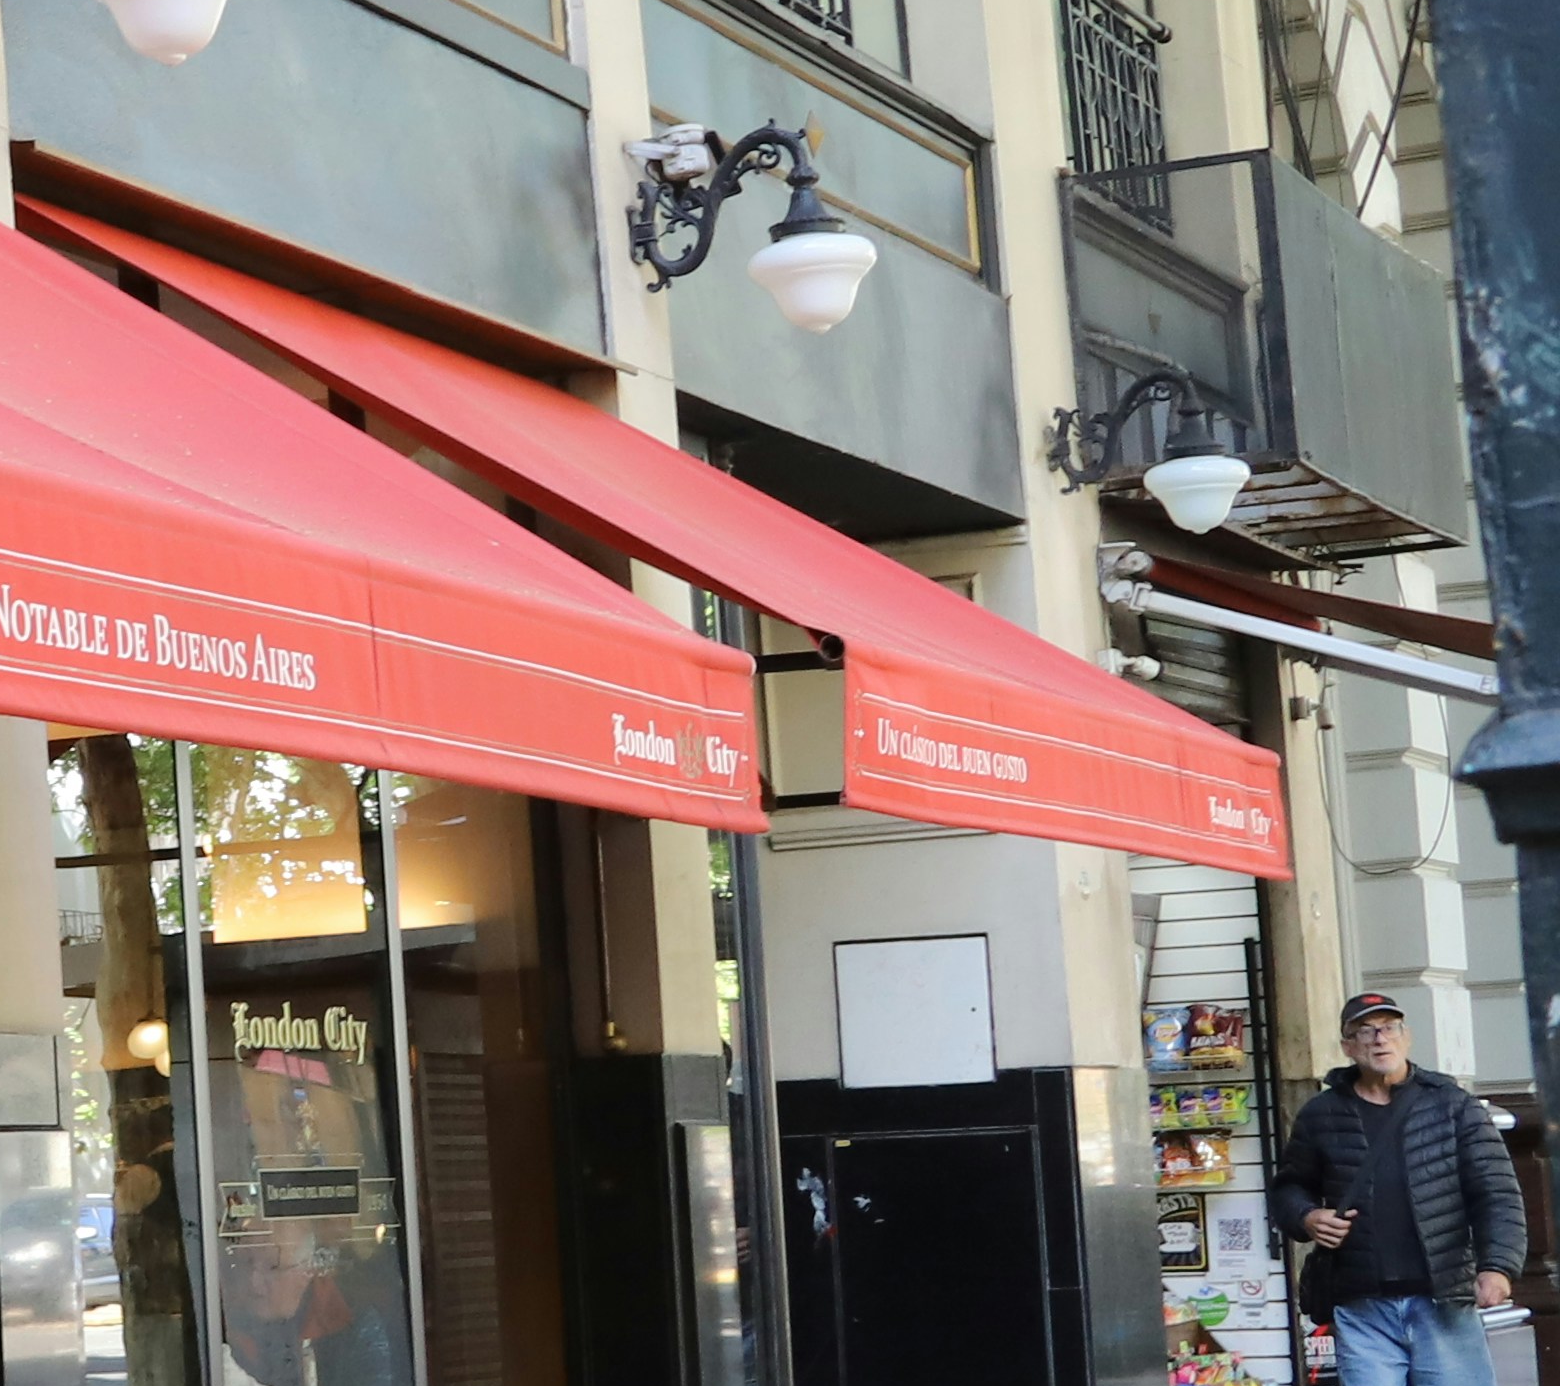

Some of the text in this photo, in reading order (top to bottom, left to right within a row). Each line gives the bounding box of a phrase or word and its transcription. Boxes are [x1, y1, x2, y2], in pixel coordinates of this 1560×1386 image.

[114, 617, 151, 663] DE
[152, 612, 249, 680] BUENOS
[251, 633, 318, 692] AIRES
[610, 712, 740, 788] London City
[876, 717, 900, 757] UN
[231, 1001, 368, 1065] London City
